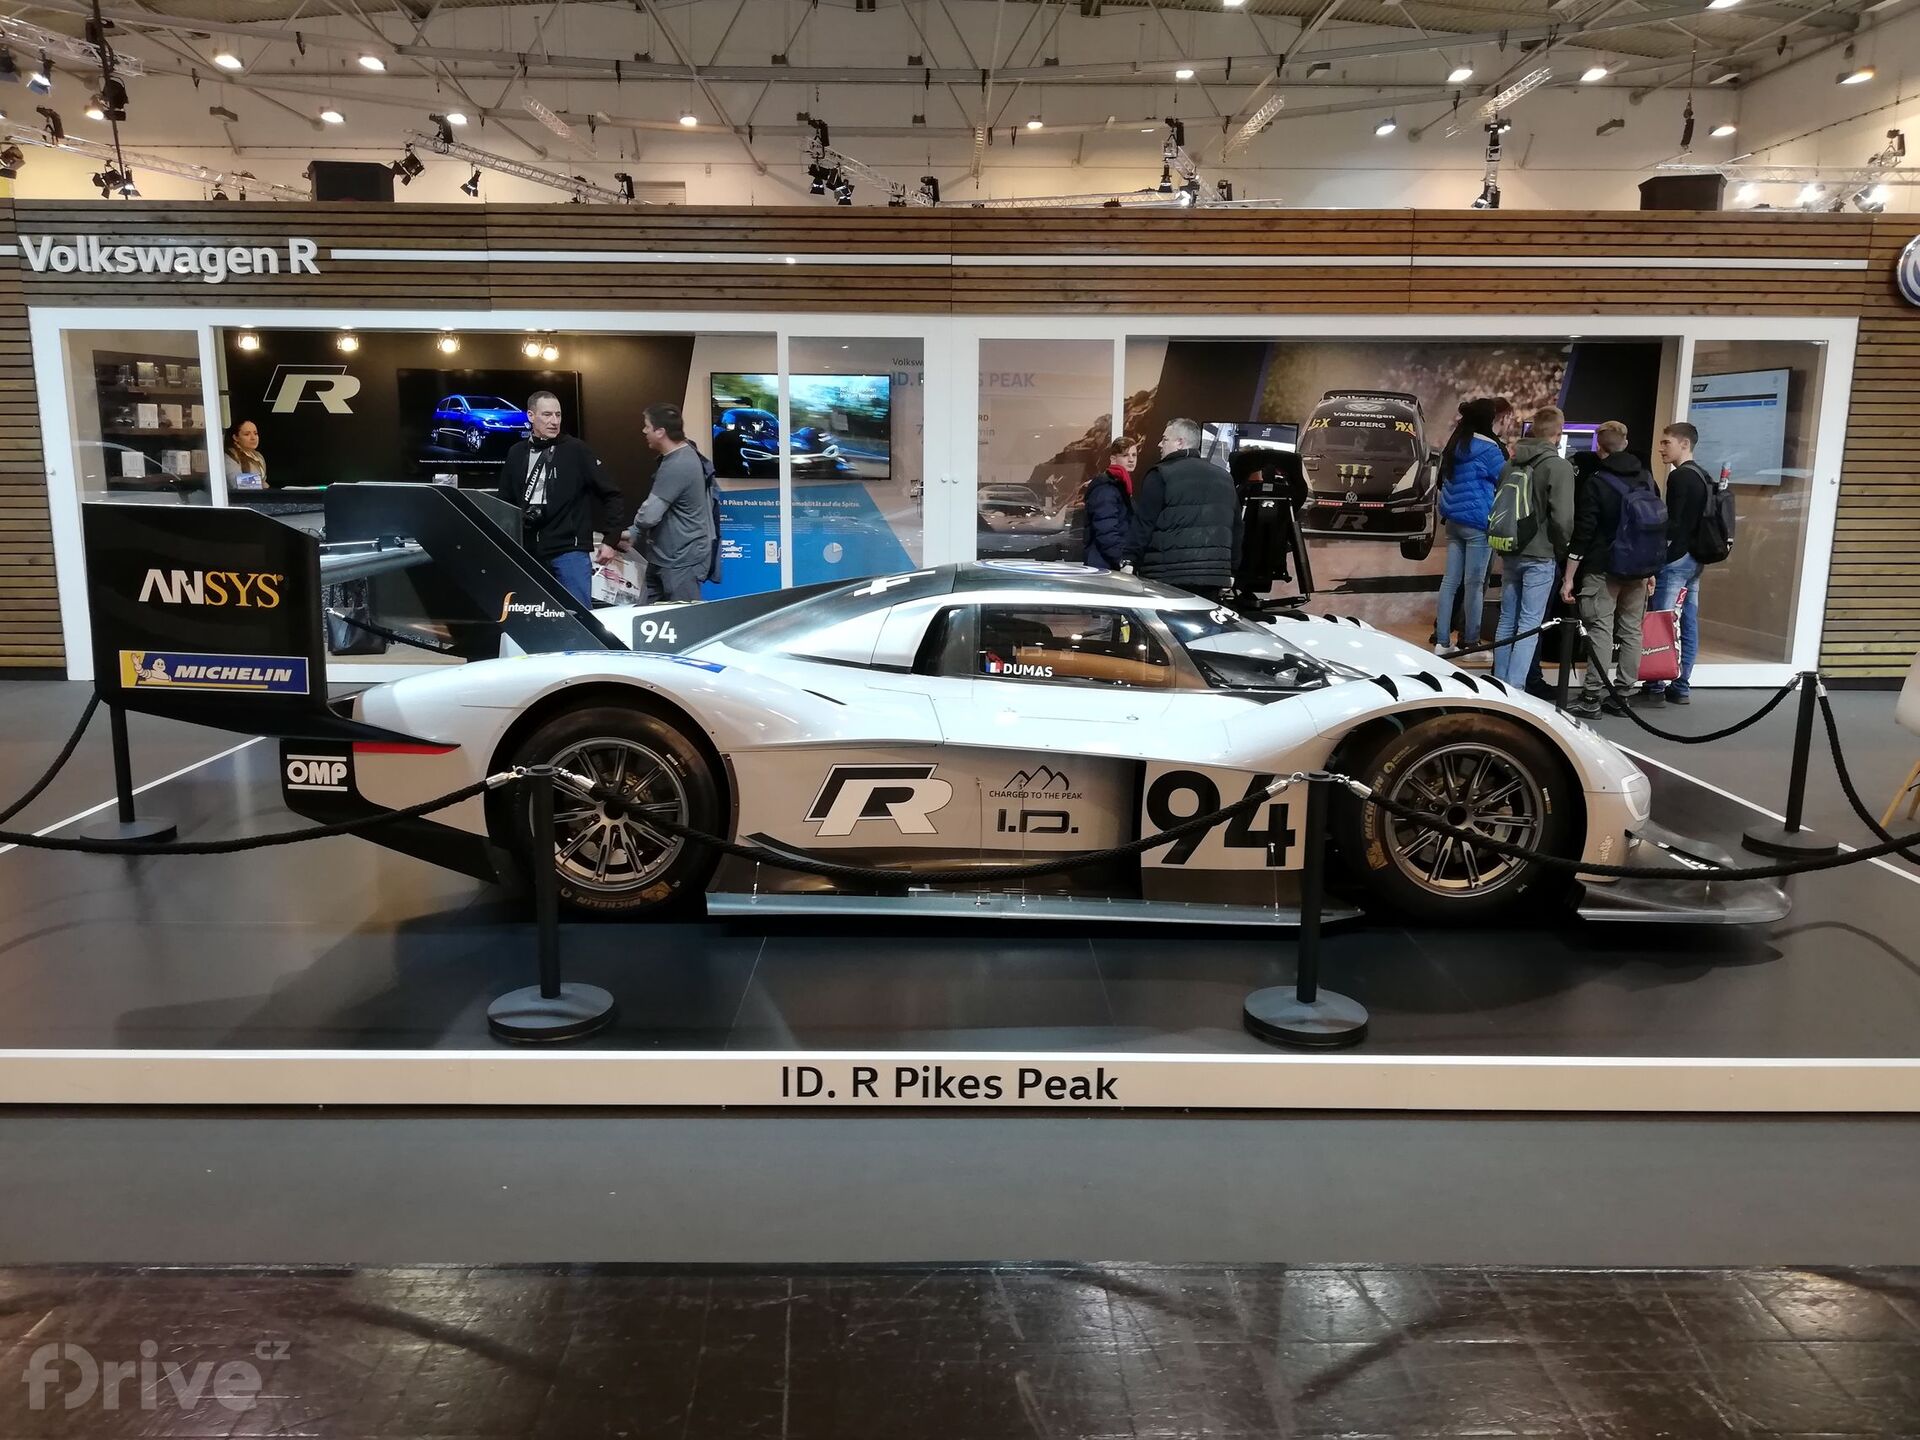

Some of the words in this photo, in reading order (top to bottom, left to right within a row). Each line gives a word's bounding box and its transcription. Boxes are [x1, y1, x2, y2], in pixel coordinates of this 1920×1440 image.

[18, 235, 279, 283] Volkswagen
[288, 238, 321, 275] R
[265, 366, 360, 413] R
[988, 372, 1035, 388] PEAK
[1339, 420, 1387, 429] SOLBERG
[1488, 536, 1514, 551] NIKE
[139, 568, 281, 608] ANSYS
[535, 609, 565, 618] e-drive
[640, 620, 677, 644] 94
[174, 665, 293, 682] MICHELIN
[1003, 663, 1053, 678] DUMAS
[287, 760, 348, 785] OMP
[803, 763, 953, 836] R
[989, 790, 1029, 799] CHARGED
[1031, 791, 1042, 799] TO
[1061, 792, 1082, 800] PEAK
[1147, 770, 1296, 867] 94
[781, 1066, 836, 1098] ID.
[852, 1066, 879, 1098] R
[895, 1065, 1003, 1100] Pikes
[1018, 1067, 1119, 1101] Peak
